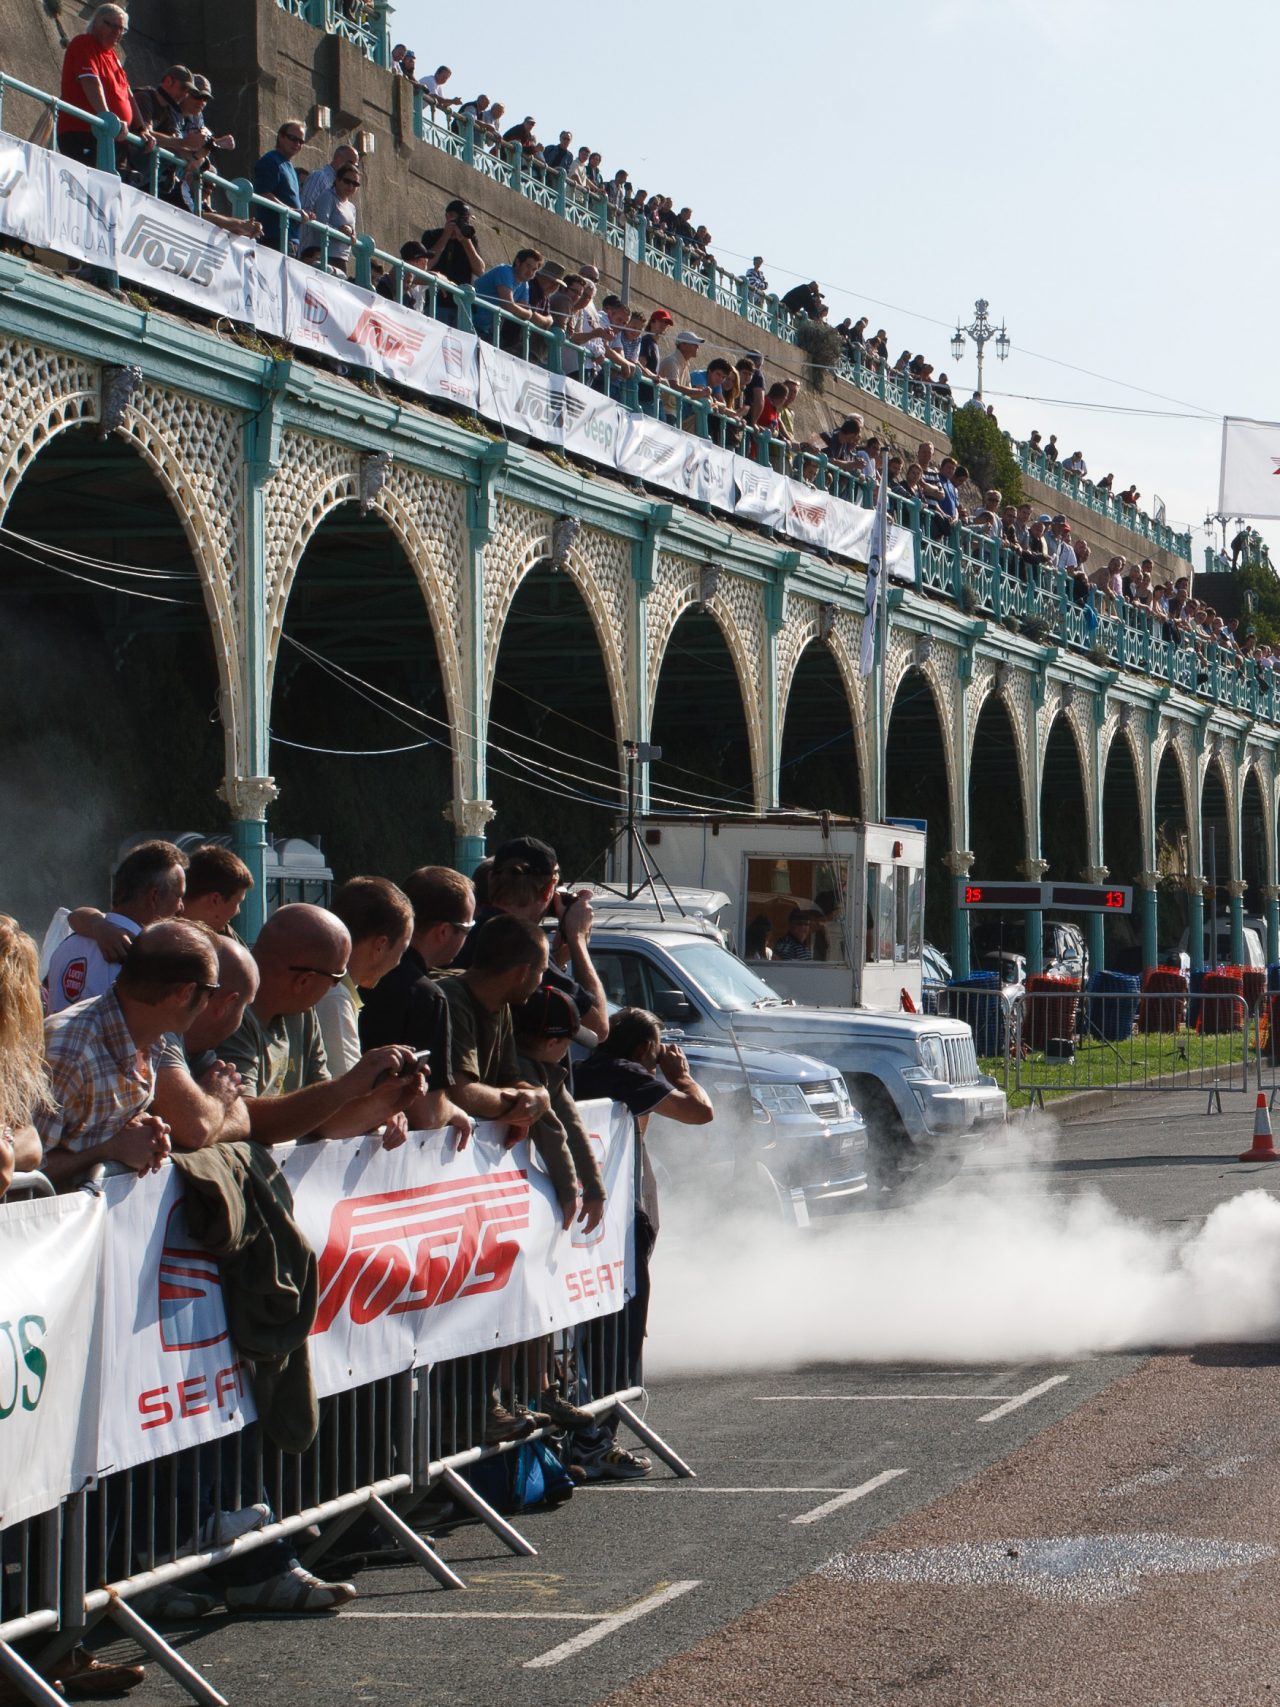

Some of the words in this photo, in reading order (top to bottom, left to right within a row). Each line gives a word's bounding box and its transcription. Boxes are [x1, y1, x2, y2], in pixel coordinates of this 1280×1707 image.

[51, 217, 116, 257] JAGUA
[439, 379, 472, 399] SEAT
[584, 410, 613, 449] Jeep
[1105, 891, 1124, 908] 13
[565, 1260, 624, 1302] SEAT
[138, 1362, 246, 1431] SEA
